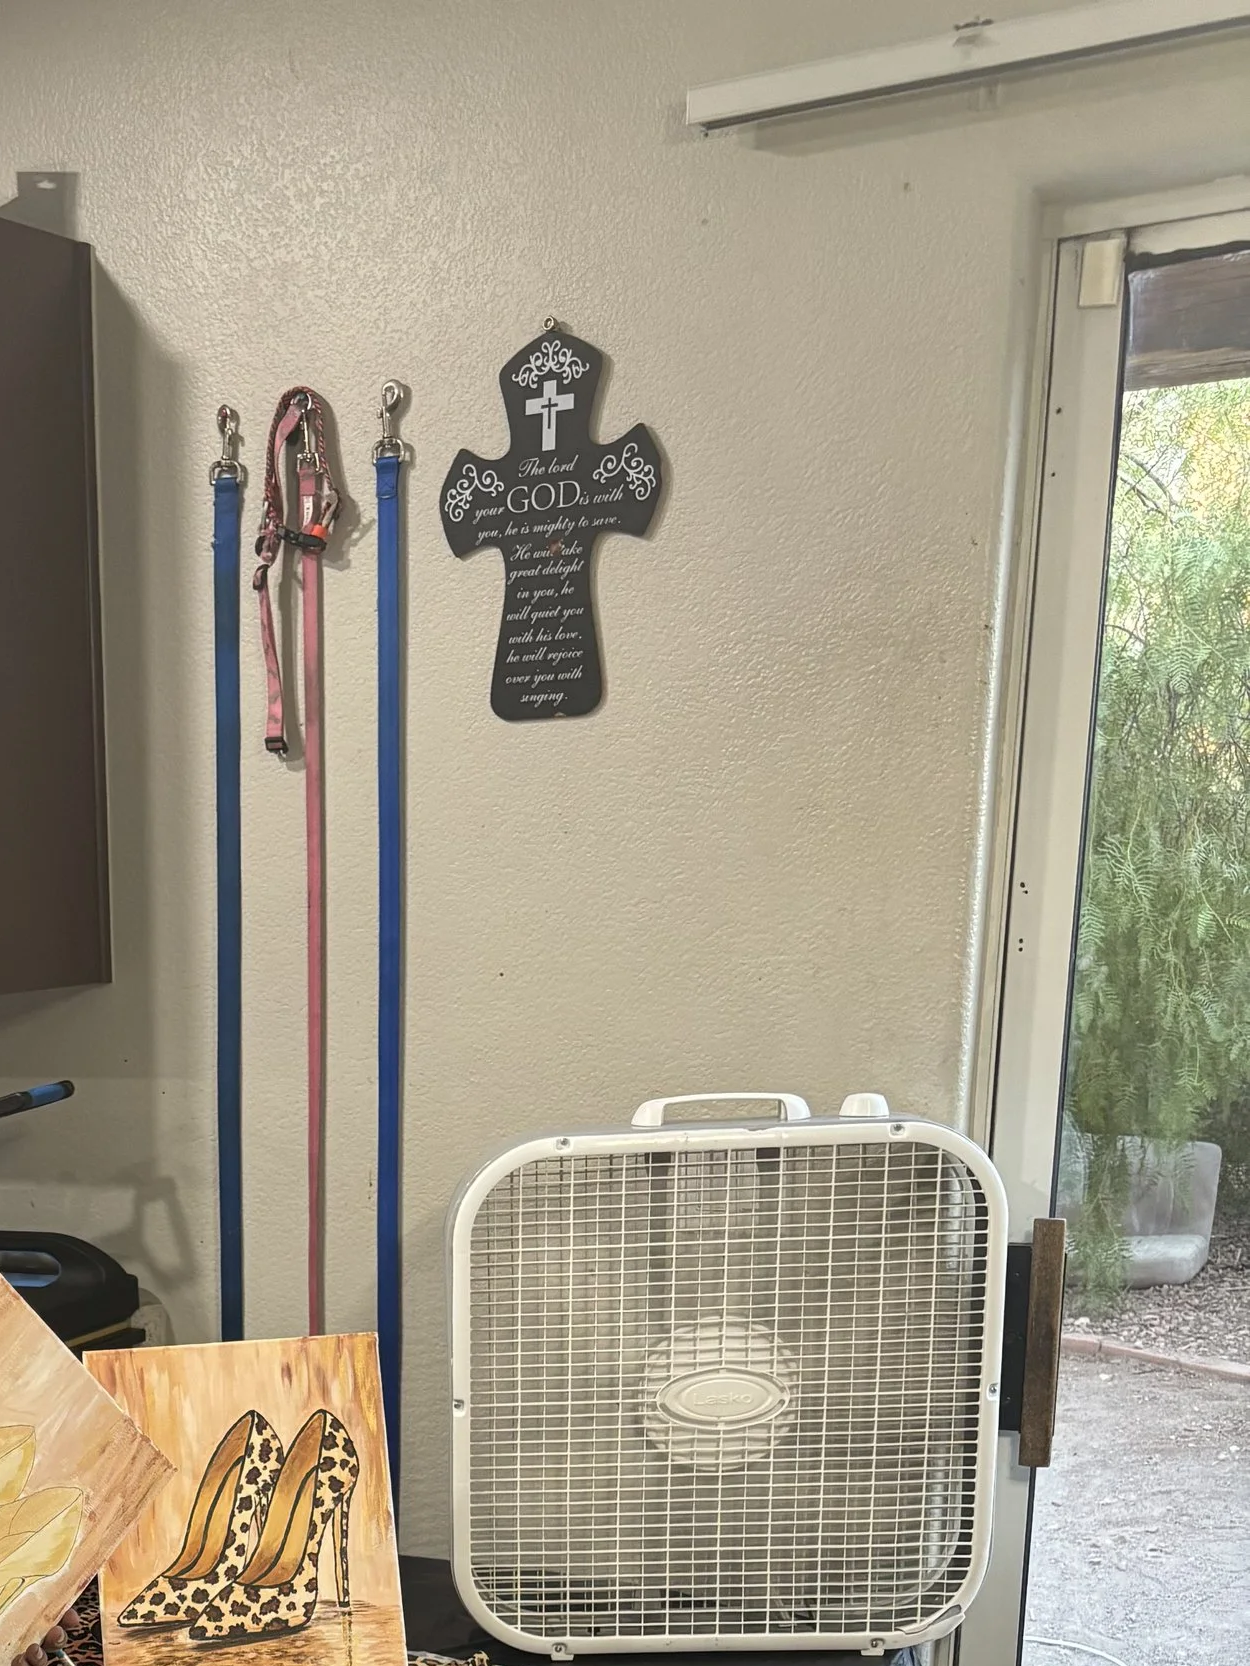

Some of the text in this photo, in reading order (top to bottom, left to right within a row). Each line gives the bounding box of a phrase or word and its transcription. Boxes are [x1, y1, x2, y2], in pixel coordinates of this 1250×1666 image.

[518, 454, 579, 478] The lord
[472, 480, 625, 525] your GOD is with
[475, 515, 621, 546] you, he is mighty to save.
[510, 543, 532, 561] He
[533, 542, 557, 558] wi
[507, 557, 584, 585] great delight
[516, 580, 575, 605] in you, he
[506, 605, 585, 625] will quiet you
[508, 626, 583, 644] with his love.
[506, 646, 584, 666] he will rejoice
[505, 665, 583, 689] over you with
[520, 690, 568, 708] singing.
[694, 1392, 754, 1406] Lasko
